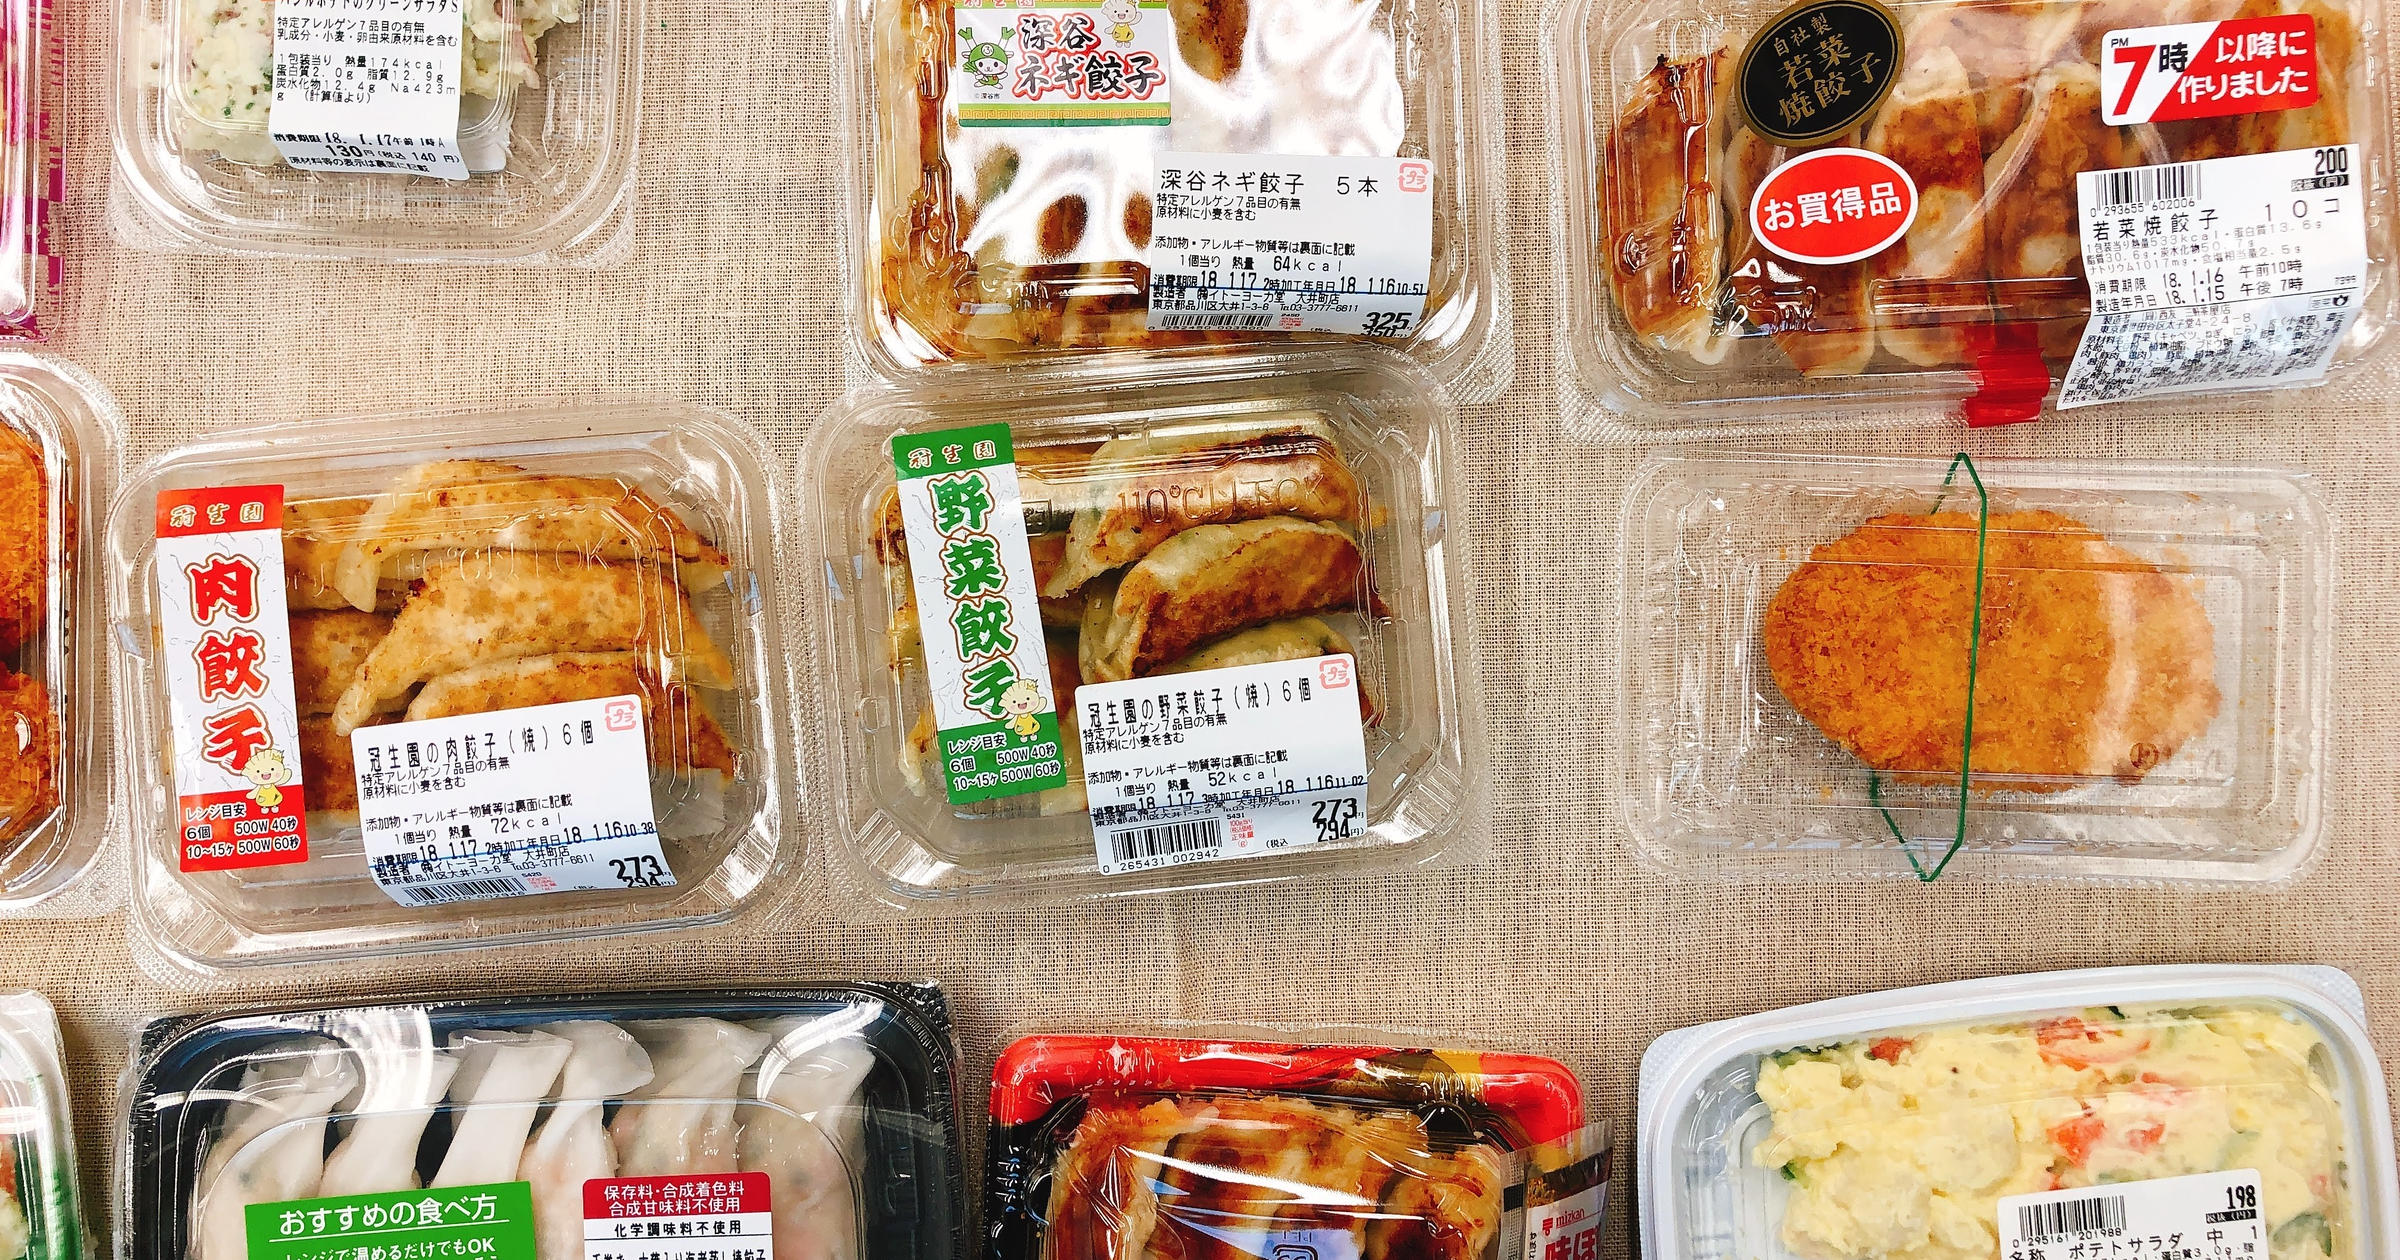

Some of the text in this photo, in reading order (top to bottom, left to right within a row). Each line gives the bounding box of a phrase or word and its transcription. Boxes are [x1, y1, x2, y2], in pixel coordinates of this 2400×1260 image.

[1021, 16, 1095, 51] 深谷
[1773, 13, 1832, 56] 自社製
[2110, 38, 2129, 48] PM
[2215, 31, 2308, 64] 以降に
[1777, 33, 1851, 89] 若菜
[1019, 53, 1159, 96] ネギ餃子
[2177, 66, 2309, 105] 作りました
[2315, 147, 2348, 175] 200
[1160, 169, 1379, 197] 深谷ネギ餃子 5本
[1156, 194, 1301, 210] 特定アレルゲン7品目の有無
[1156, 206, 1256, 221] 原材料に小麦を含む
[1764, 182, 1903, 232] お買得品
[2093, 209, 2218, 241] 若菜焼餃子
[2095, 277, 2146, 294] 消費期限
[2095, 294, 2157, 313] 製造年月日
[930, 475, 1017, 717] 野菜餃子
[190, 557, 269, 772] 肉餃子
[1083, 713, 1227, 741] 特定アレルゲン7品目の有無
[948, 733, 1006, 755] レンジ目安
[1084, 732, 1184, 755] 原材料に小麦を含む
[951, 744, 1056, 772] 6個 500W 40秒
[361, 757, 511, 787] 特定アレルゲン7品目の有無
[1001, 766, 1032, 783] 500W
[1035, 762, 1060, 777] 60秒
[363, 777, 466, 800] 原材料に小麦を含む
[187, 804, 245, 820] レンジ目安
[187, 817, 297, 839] 6個 500W 40秒
[239, 839, 271, 853] 500W
[274, 836, 299, 850] 60秒
[1120, 857, 1165, 871] 265431
[1172, 849, 1219, 863] 002942
[609, 1197, 740, 1217] 合成甘味料不使用
[2226, 1184, 2256, 1209] 198
[279, 1193, 498, 1236] おすすめの食べ方
[1556, 1208, 1585, 1227] mizkan
[614, 1220, 742, 1238] 化学調味料不使用
[2027, 1234, 2068, 1246] 295161
[2079, 1228, 2122, 1241] 201988
[2069, 1232, 2183, 1260] ポテトサラダ
[2206, 1228, 2223, 1246] 中
